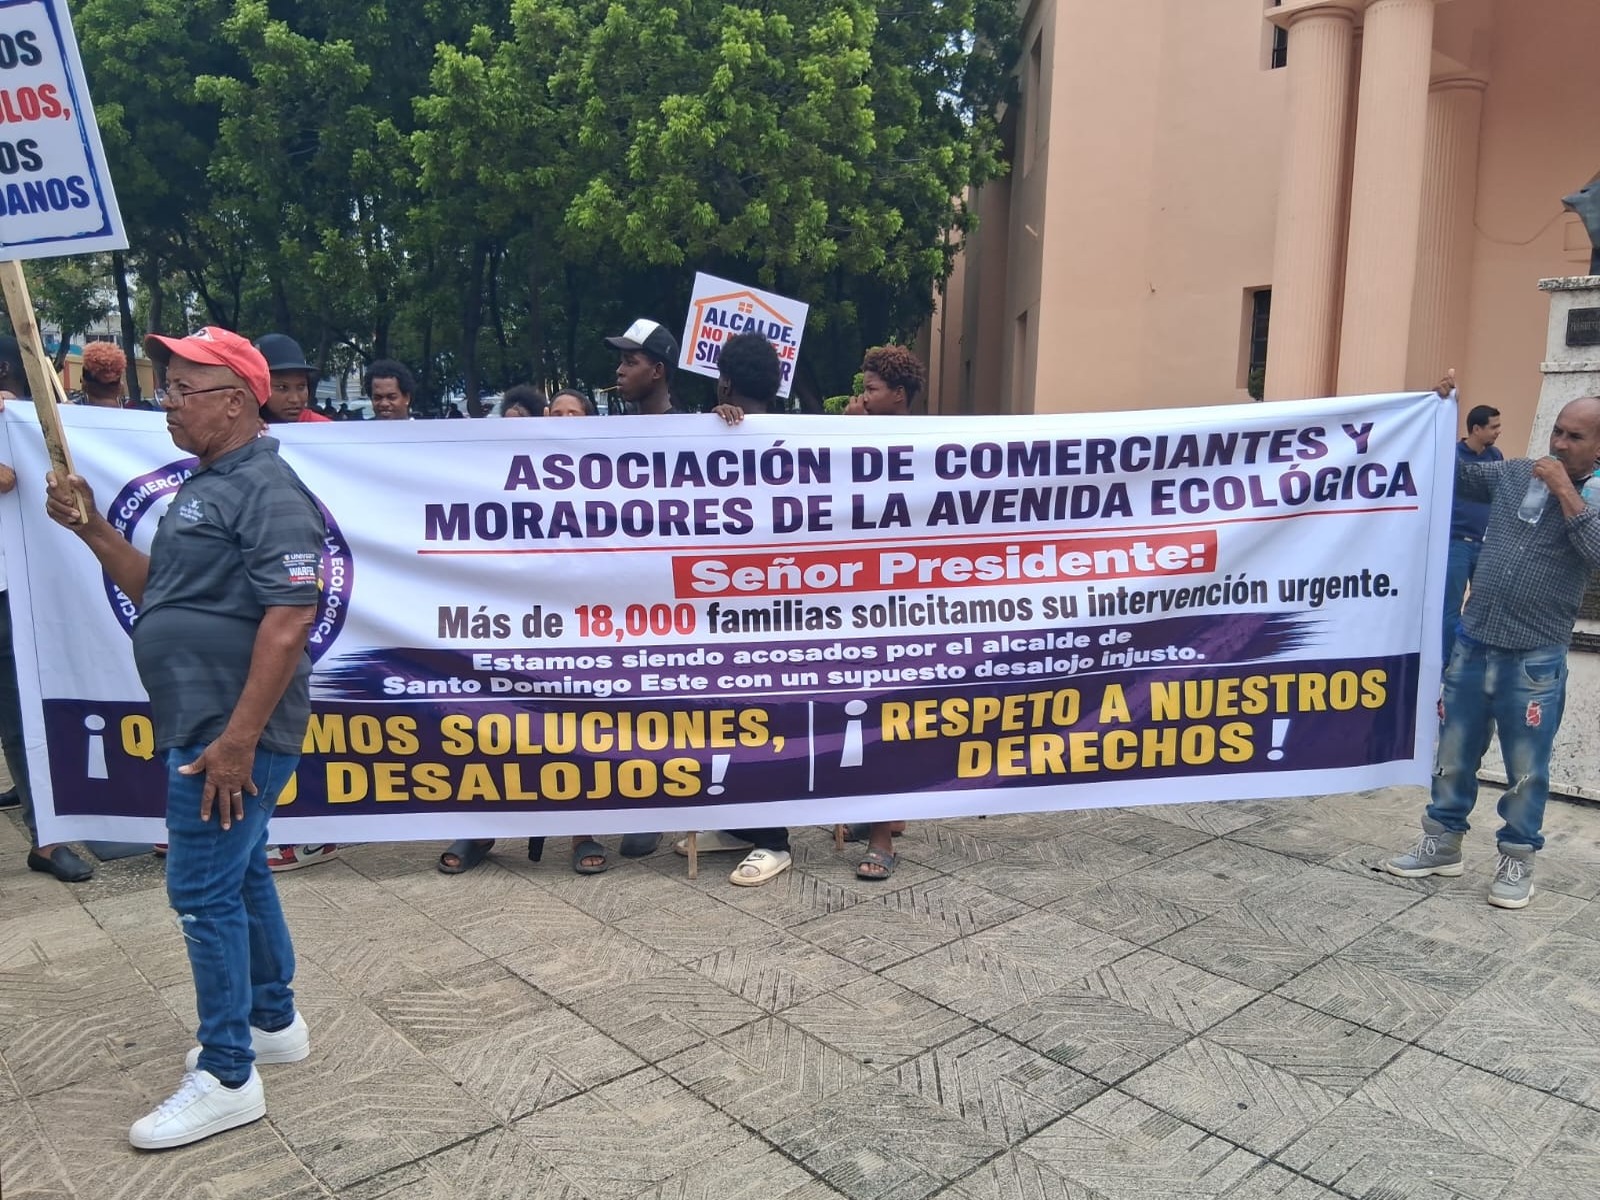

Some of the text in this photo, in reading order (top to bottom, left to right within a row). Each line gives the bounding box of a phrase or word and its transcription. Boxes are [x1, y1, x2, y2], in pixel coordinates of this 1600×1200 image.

[0, 84, 71, 123] LOS,
[701, 325, 723, 342] NO
[504, 422, 1374, 491] ASOCIACIÓN DE COMERCIANTES Y
[425, 461, 1418, 541] MORADORES DE LA AVENIDA ECOLÓGICA
[690, 541, 1205, 593] Señor Presidente:
[310, 557, 344, 645] ECOLÓGICA
[438, 568, 1398, 643] Más de 18,000 familias solicitamos su intervención urgente.
[383, 645, 1205, 698] Santo Domingo Este con un supuesto desalojo injusto.
[473, 629, 1132, 671] Estamos siendo acosados por el alcalde de
[440, 708, 785, 756] SOLUCIONES,
[881, 688, 1080, 742] RESPETO
[1098, 683, 1131, 723] A
[1150, 669, 1387, 722] NUESTROS
